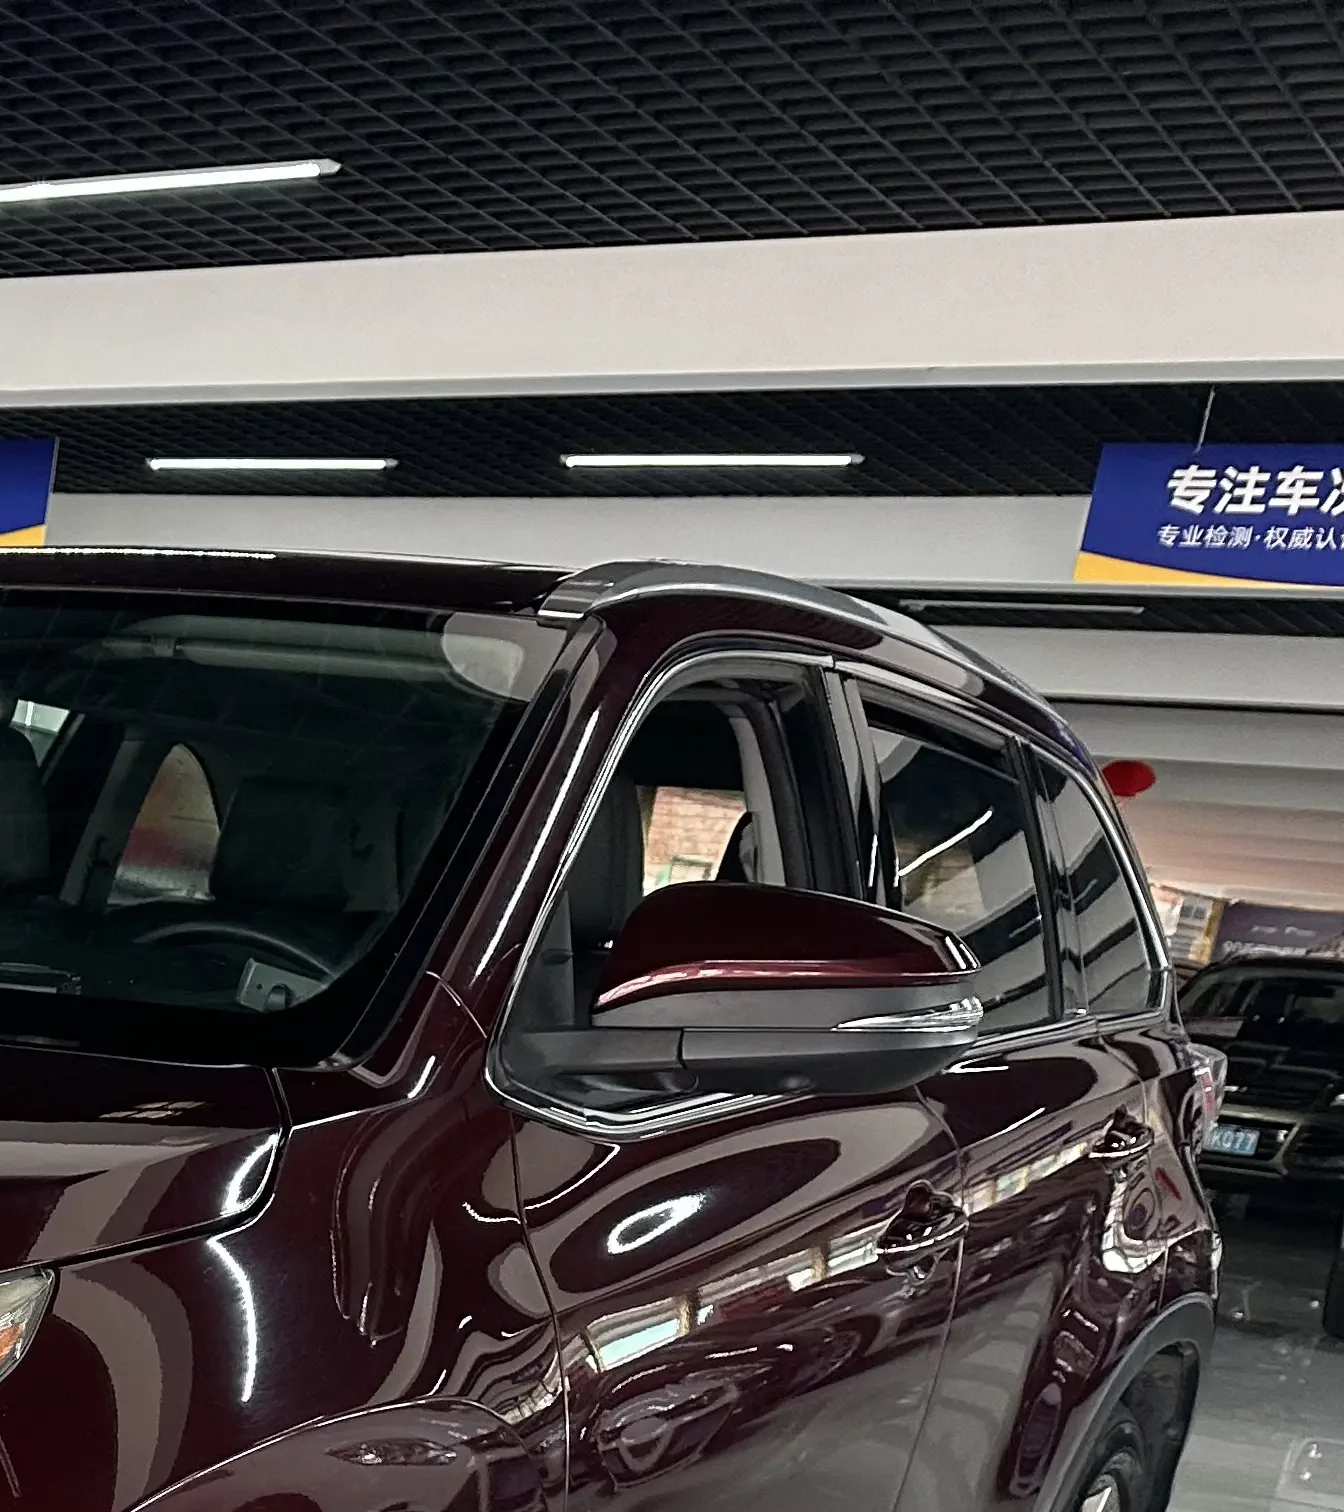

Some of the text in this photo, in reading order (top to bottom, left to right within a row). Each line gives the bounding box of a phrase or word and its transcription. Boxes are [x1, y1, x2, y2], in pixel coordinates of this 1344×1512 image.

[1157, 523, 1344, 551] 专业检测·权威认
